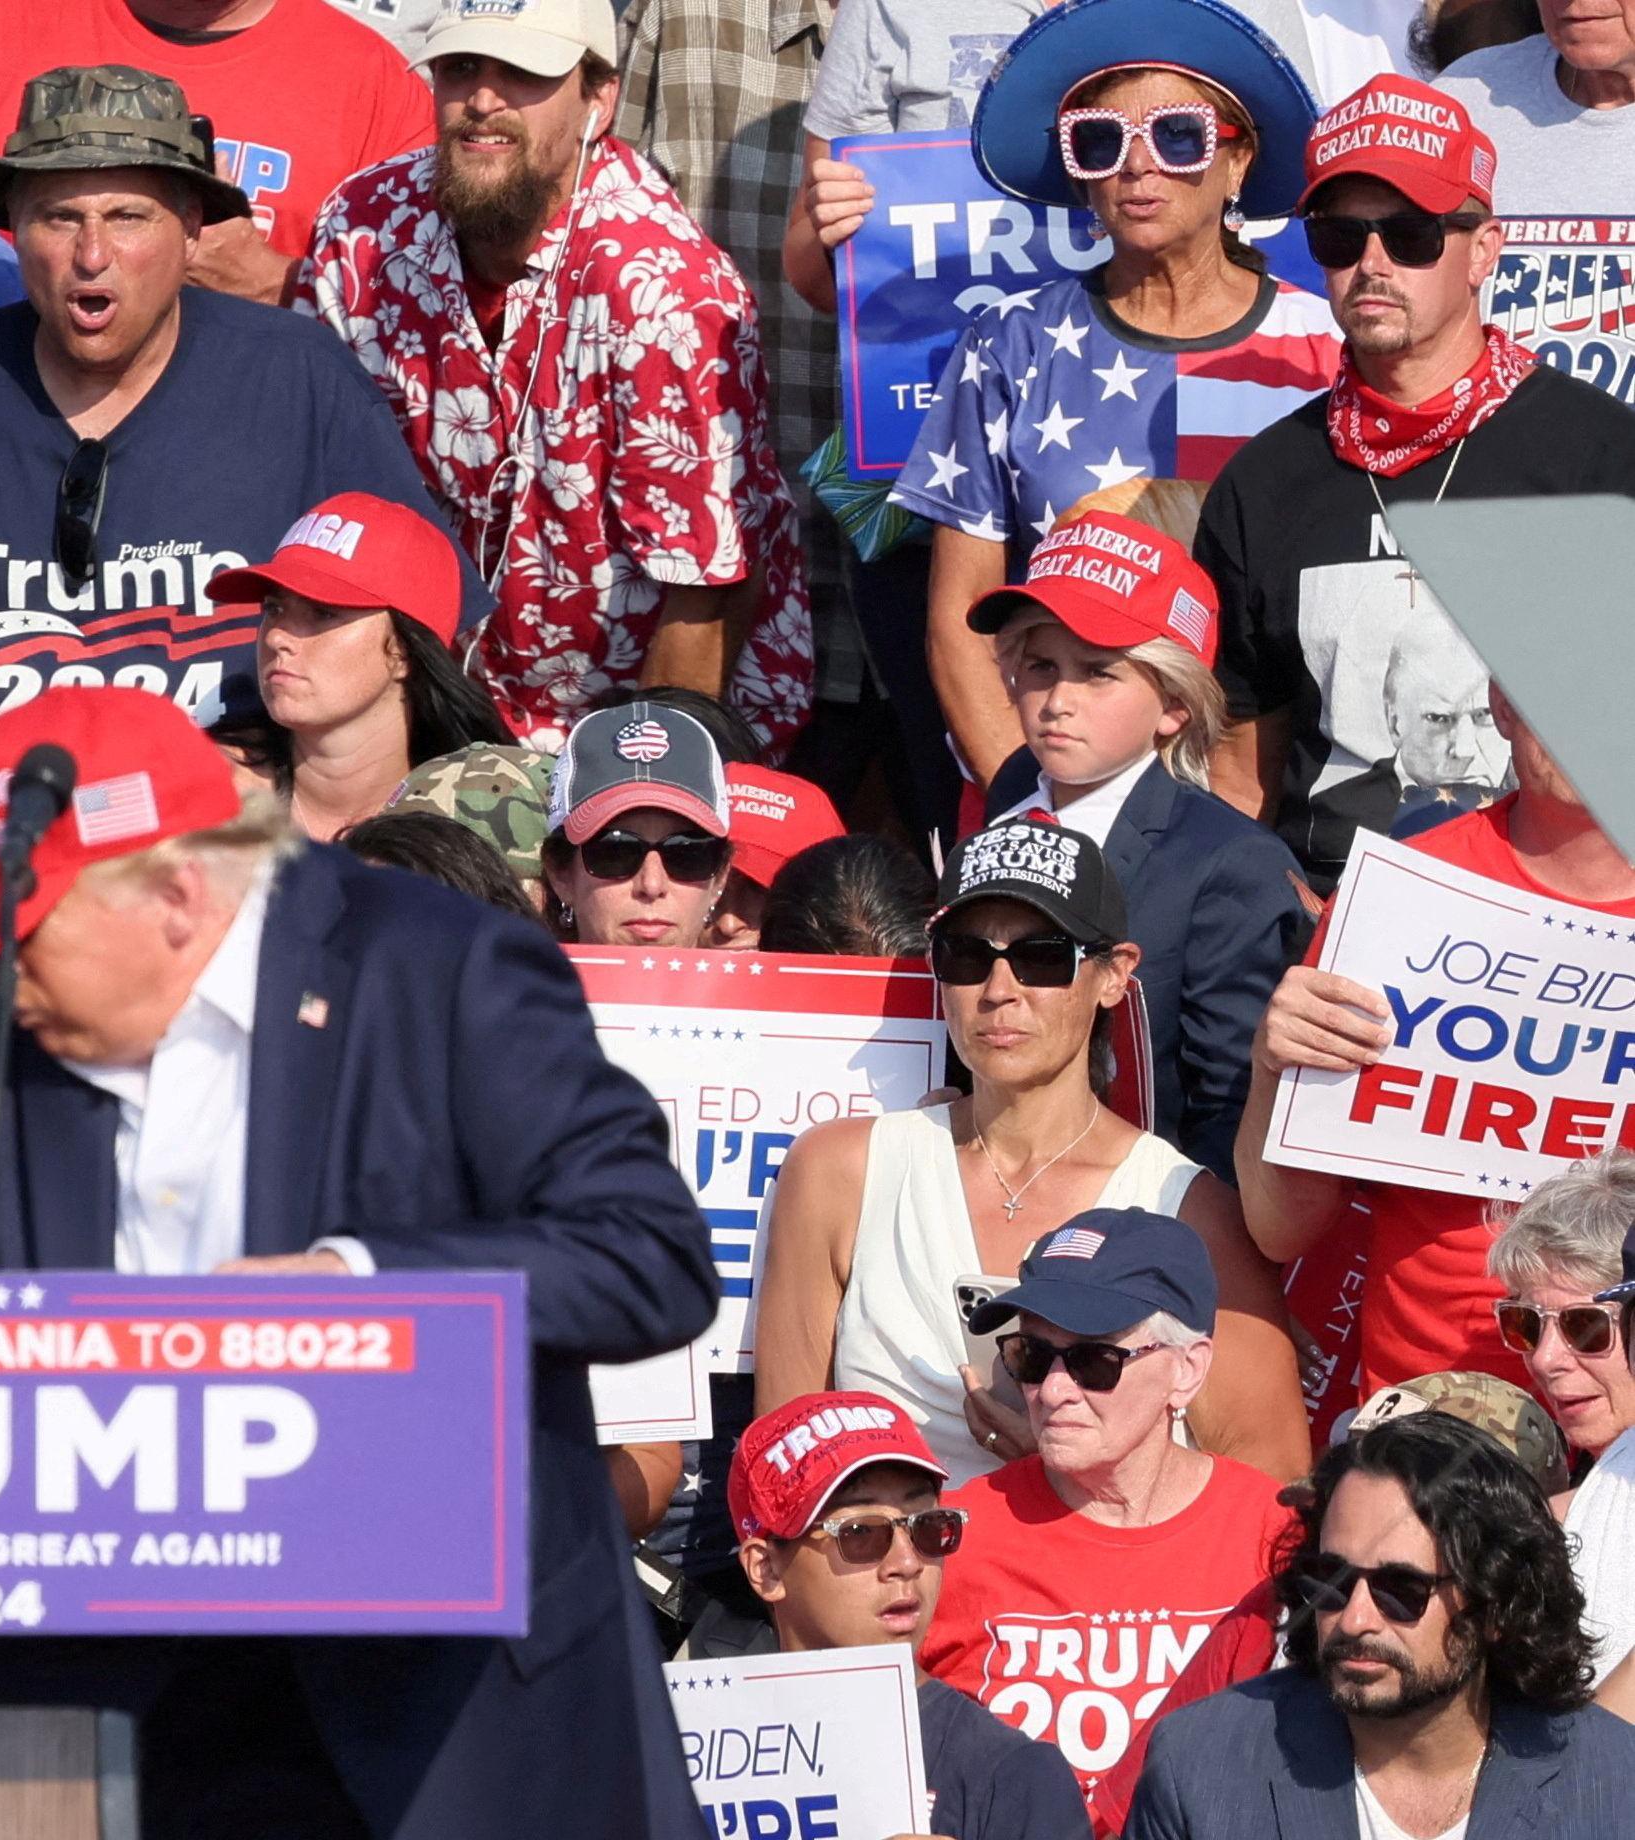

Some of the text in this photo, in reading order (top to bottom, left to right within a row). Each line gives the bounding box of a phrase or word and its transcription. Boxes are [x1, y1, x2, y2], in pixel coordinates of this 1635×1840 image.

[1310, 91, 1462, 141] MAKE AMERICA
[1316, 122, 1447, 166] GREAT AGAIN
[118, 538, 203, 562] President
[1068, 522, 1162, 575] AMERICA
[1066, 555, 1142, 599] AGAIN
[724, 782, 796, 810] AMERICA
[733, 799, 788, 822] AGAIN
[964, 823, 1081, 857] JESUS
[1008, 840, 1077, 873] SAVIOR
[960, 848, 1077, 884] TRUMP
[969, 871, 990, 889] MY
[990, 867, 1072, 900] PRESIDENT
[1405, 933, 1539, 997] JOE
[779, 1089, 874, 1125] JOE
[1348, 1062, 1635, 1160] FIRE
[127, 1322, 208, 1370] TO
[219, 1322, 393, 1370] 88022
[763, 1406, 897, 1476] TRUMP
[130, 1531, 283, 1568] AGAIN!
[681, 1720, 824, 1782] BIDEN,
